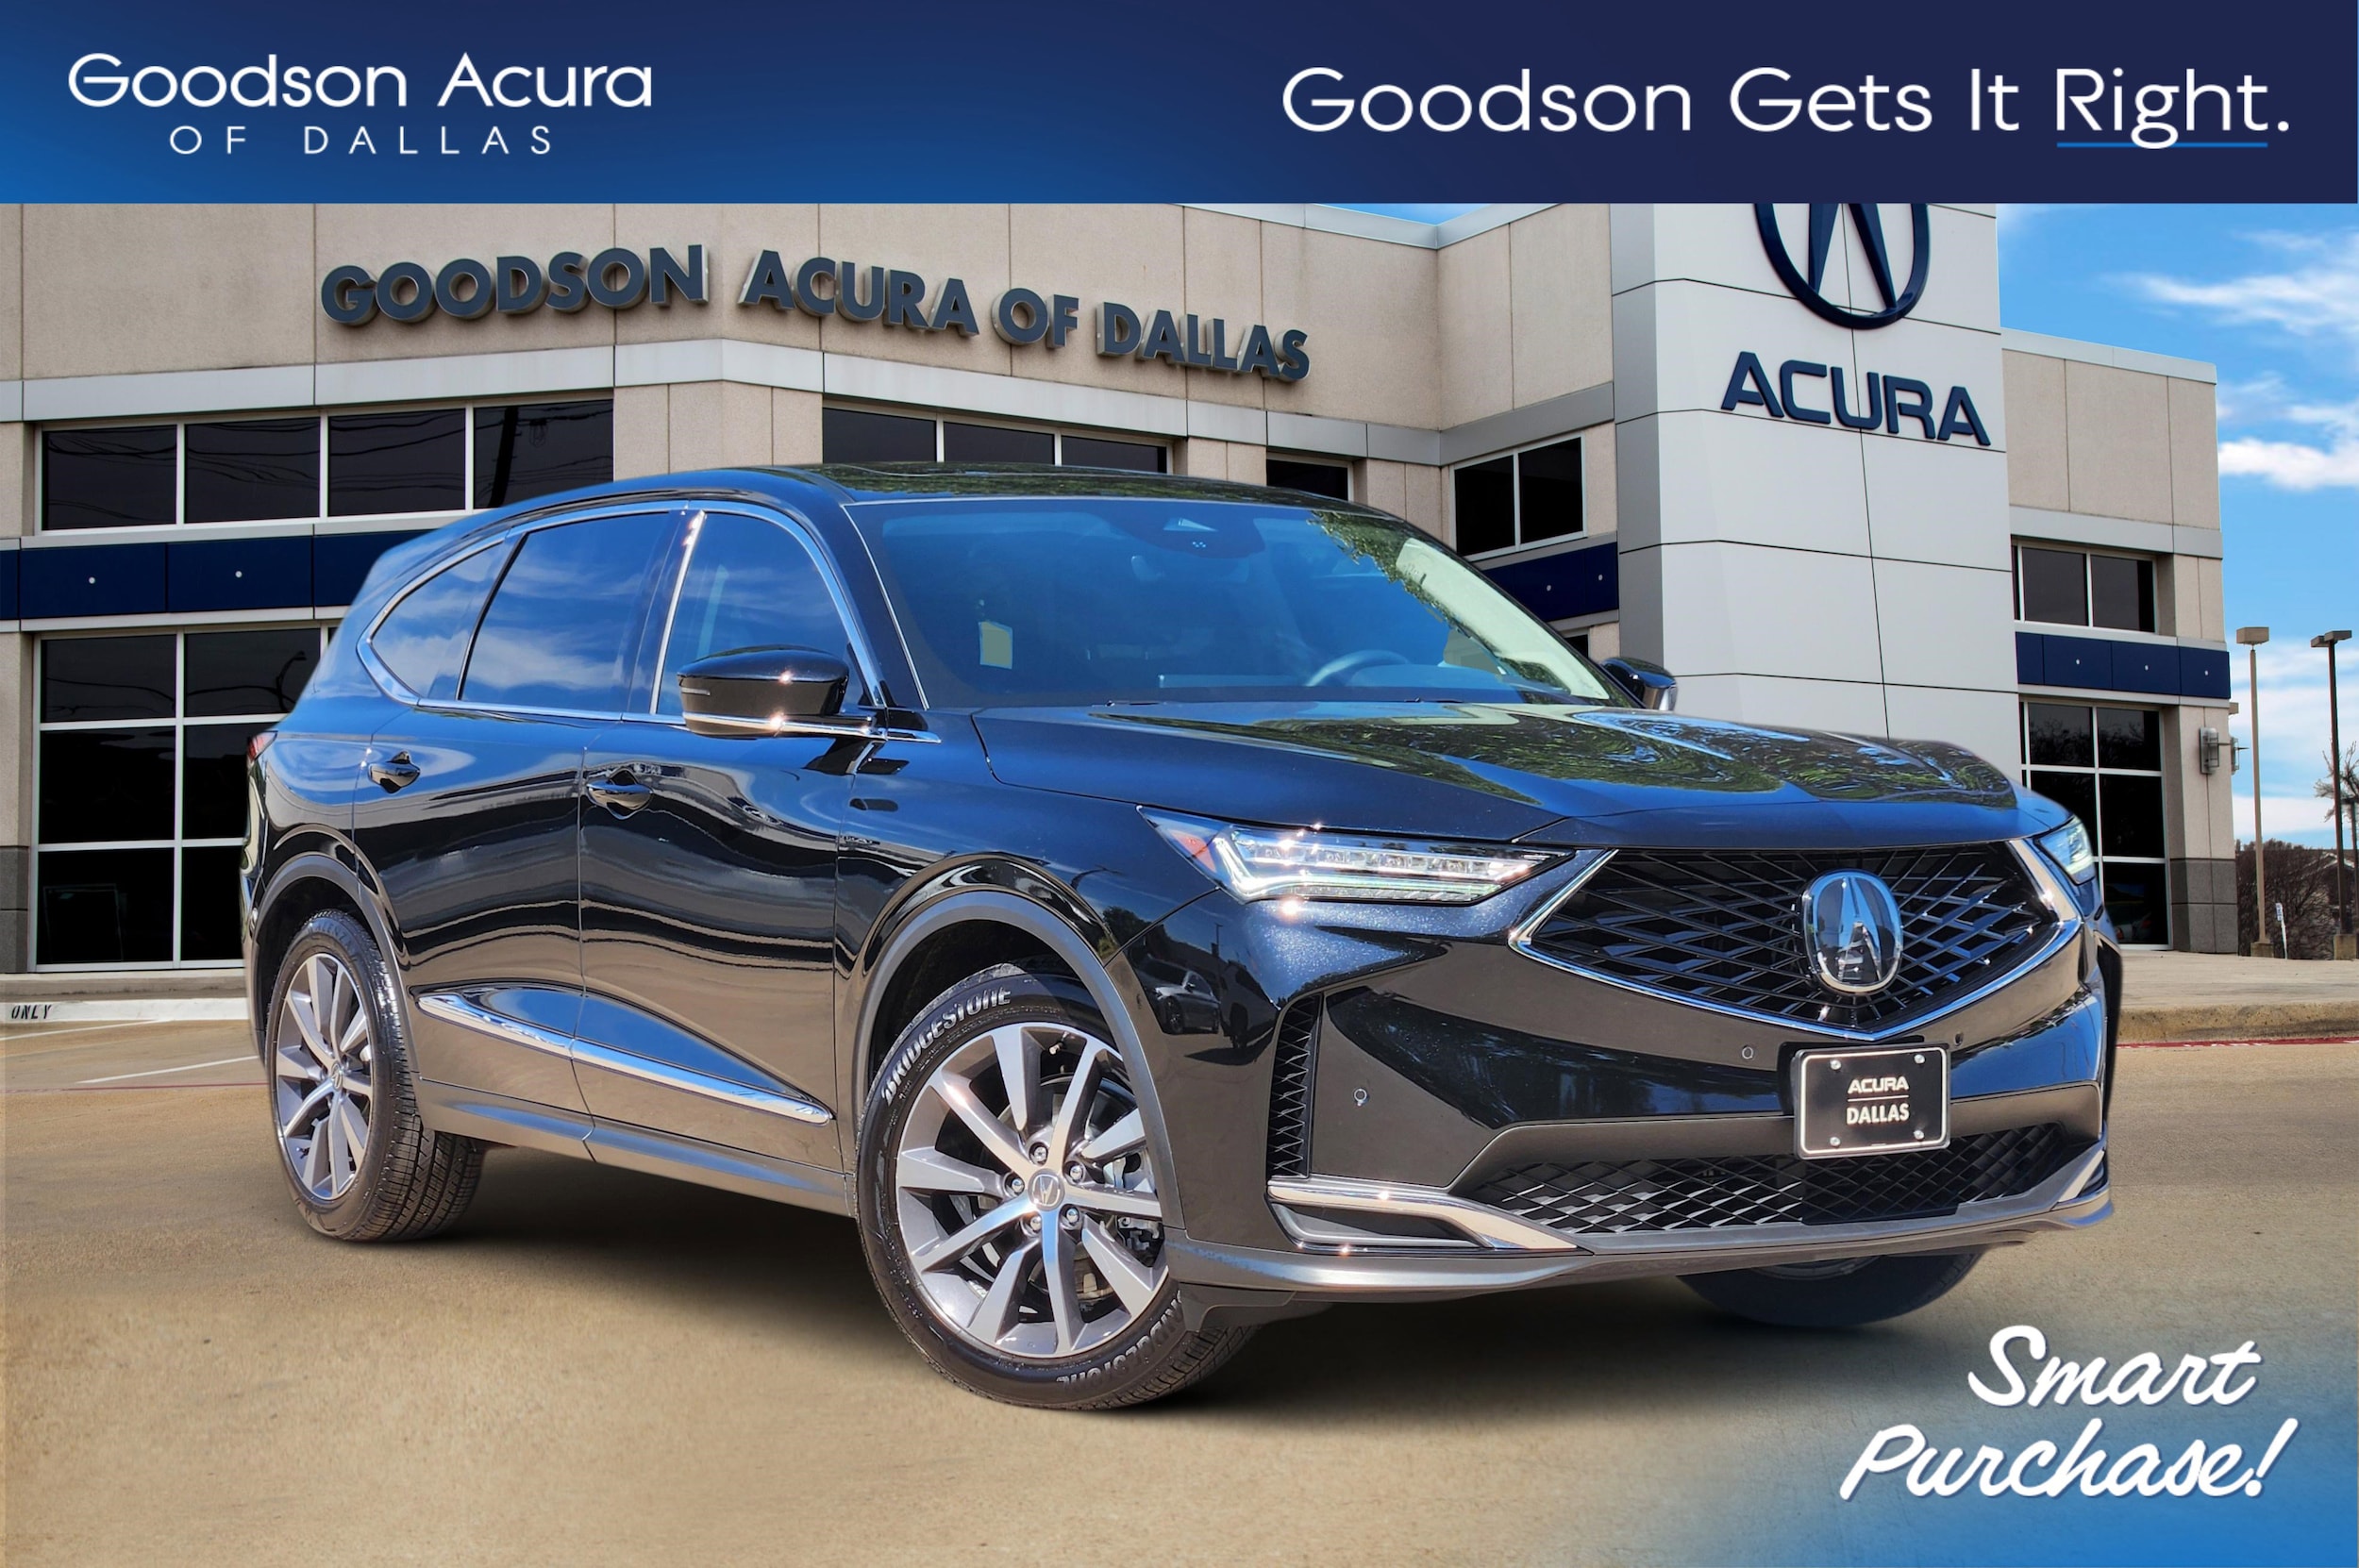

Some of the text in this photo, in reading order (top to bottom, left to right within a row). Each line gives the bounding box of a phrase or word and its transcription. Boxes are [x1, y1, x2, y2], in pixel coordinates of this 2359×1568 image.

[321, 244, 1311, 382] GOODSON ACURA OF DALLAS
[1720, 350, 1992, 447] ACURA
[11, 1004, 52, 1020] ONLY
[880, 985, 1012, 1107] BRIDGESTONE
[1846, 1102, 1910, 1126] DALLAS
[1847, 1076, 1910, 1094] ACURA
